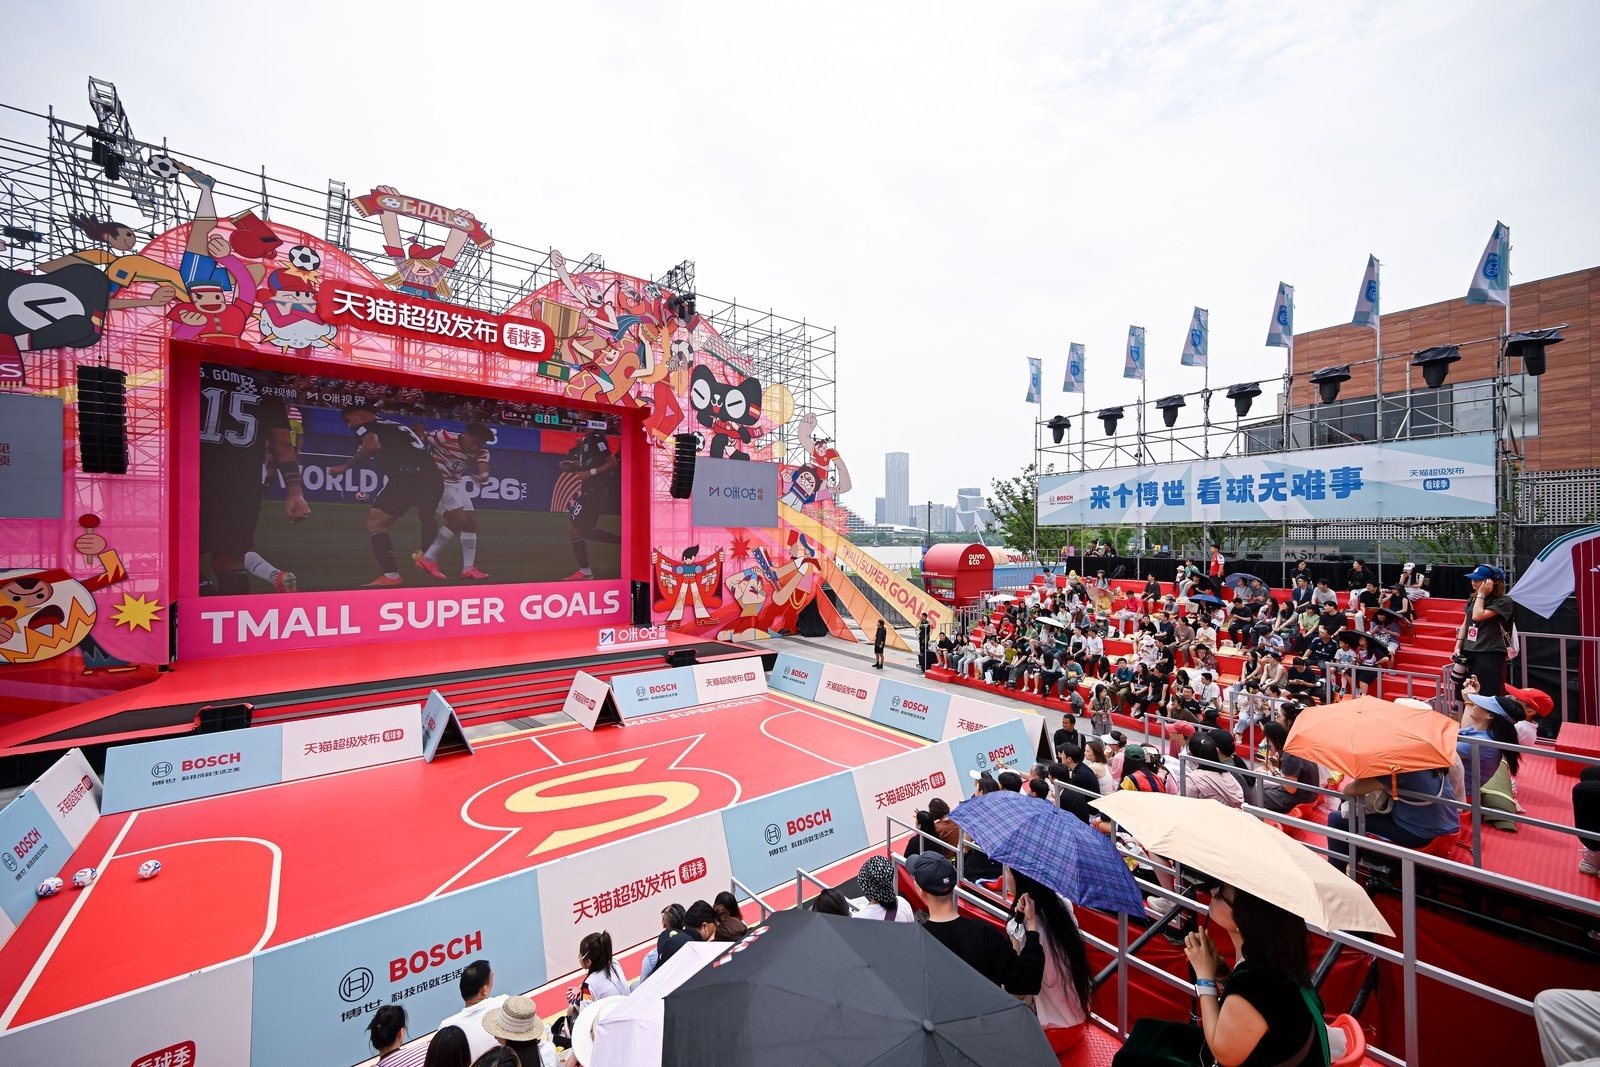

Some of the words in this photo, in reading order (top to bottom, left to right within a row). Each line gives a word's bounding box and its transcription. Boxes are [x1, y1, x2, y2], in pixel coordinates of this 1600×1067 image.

[332, 288, 498, 344] 天猫超级发布
[506, 327, 542, 349] 看球季
[262, 386, 298, 399] 央视频
[200, 387, 262, 448] 15
[1409, 467, 1465, 477] 天猫超级发布
[1090, 479, 1186, 510] 来个博世
[1197, 466, 1364, 505] 看球无难事
[860, 559, 889, 590] SUPER
[889, 581, 940, 630] GOALS
[201, 604, 361, 644] TMALL
[378, 597, 506, 633] SUPER
[519, 589, 621, 620] GOALS
[791, 668, 808, 680] BOSCH
[649, 683, 677, 694] BOSCH
[668, 705, 717, 719] SUPER
[717, 697, 764, 710] GOALS
[902, 699, 929, 714] BOSCH
[957, 718, 988, 733] 天猫超
[304, 732, 380, 756] 天猫超级发布
[988, 743, 1016, 763] BOSCH
[181, 751, 241, 771] BOSCH
[874, 778, 930, 810] 天猫超级发布
[786, 808, 832, 836] BOSCH
[13, 827, 42, 860] BOSCH
[572, 869, 677, 924] 天猫超级发布
[681, 860, 705, 880] 看球季
[389, 930, 483, 983] BOSCH
[340, 998, 382, 1022] 博世
[391, 965, 467, 1003] 科技成就生活
